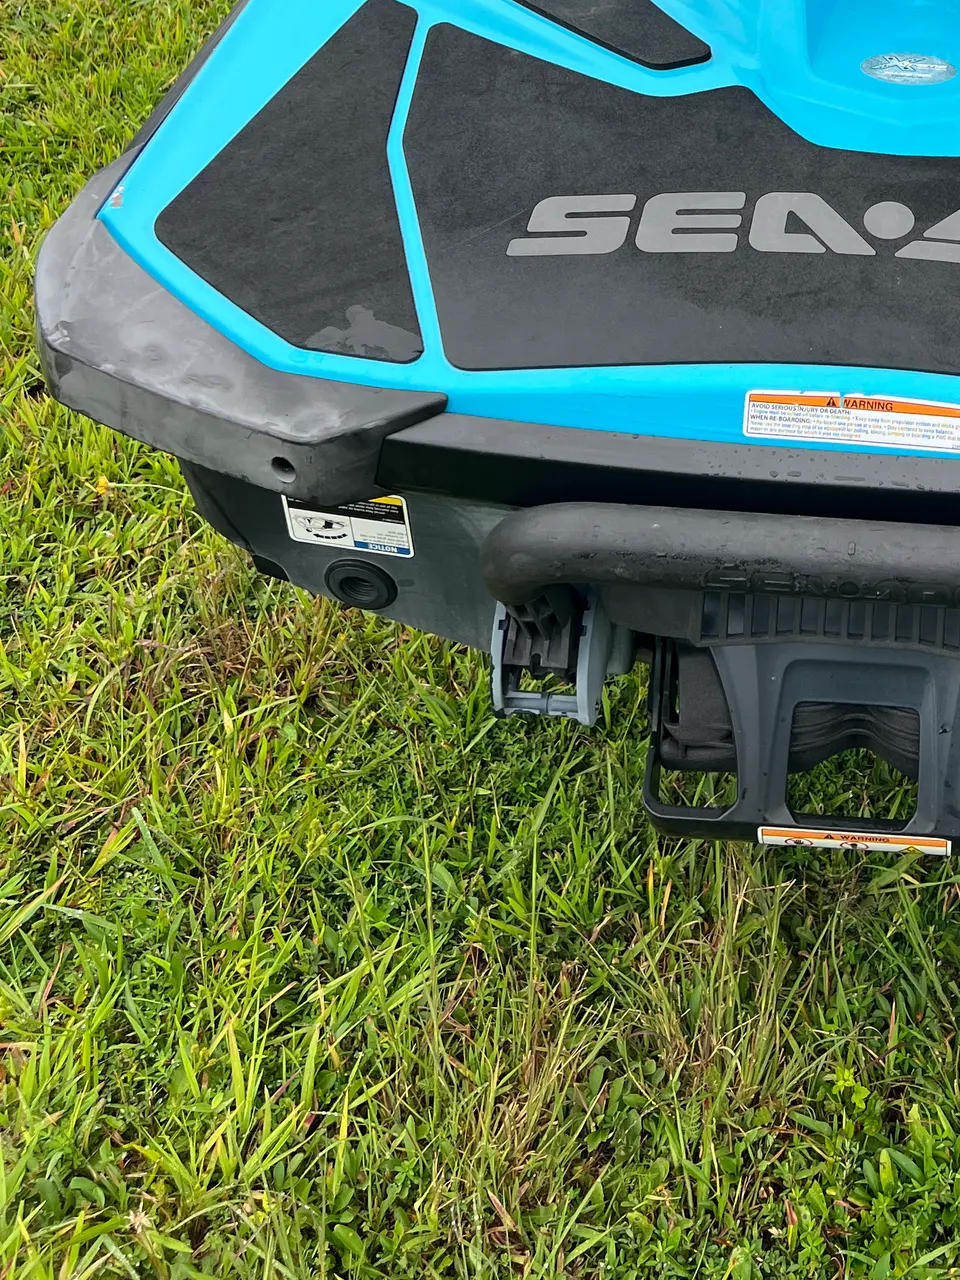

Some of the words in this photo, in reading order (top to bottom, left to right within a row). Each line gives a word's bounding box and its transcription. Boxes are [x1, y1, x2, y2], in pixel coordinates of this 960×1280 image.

[843, 399, 893, 411] WARNING
[368, 544, 397, 553] NOTICE
[840, 835, 890, 843] WARNING
